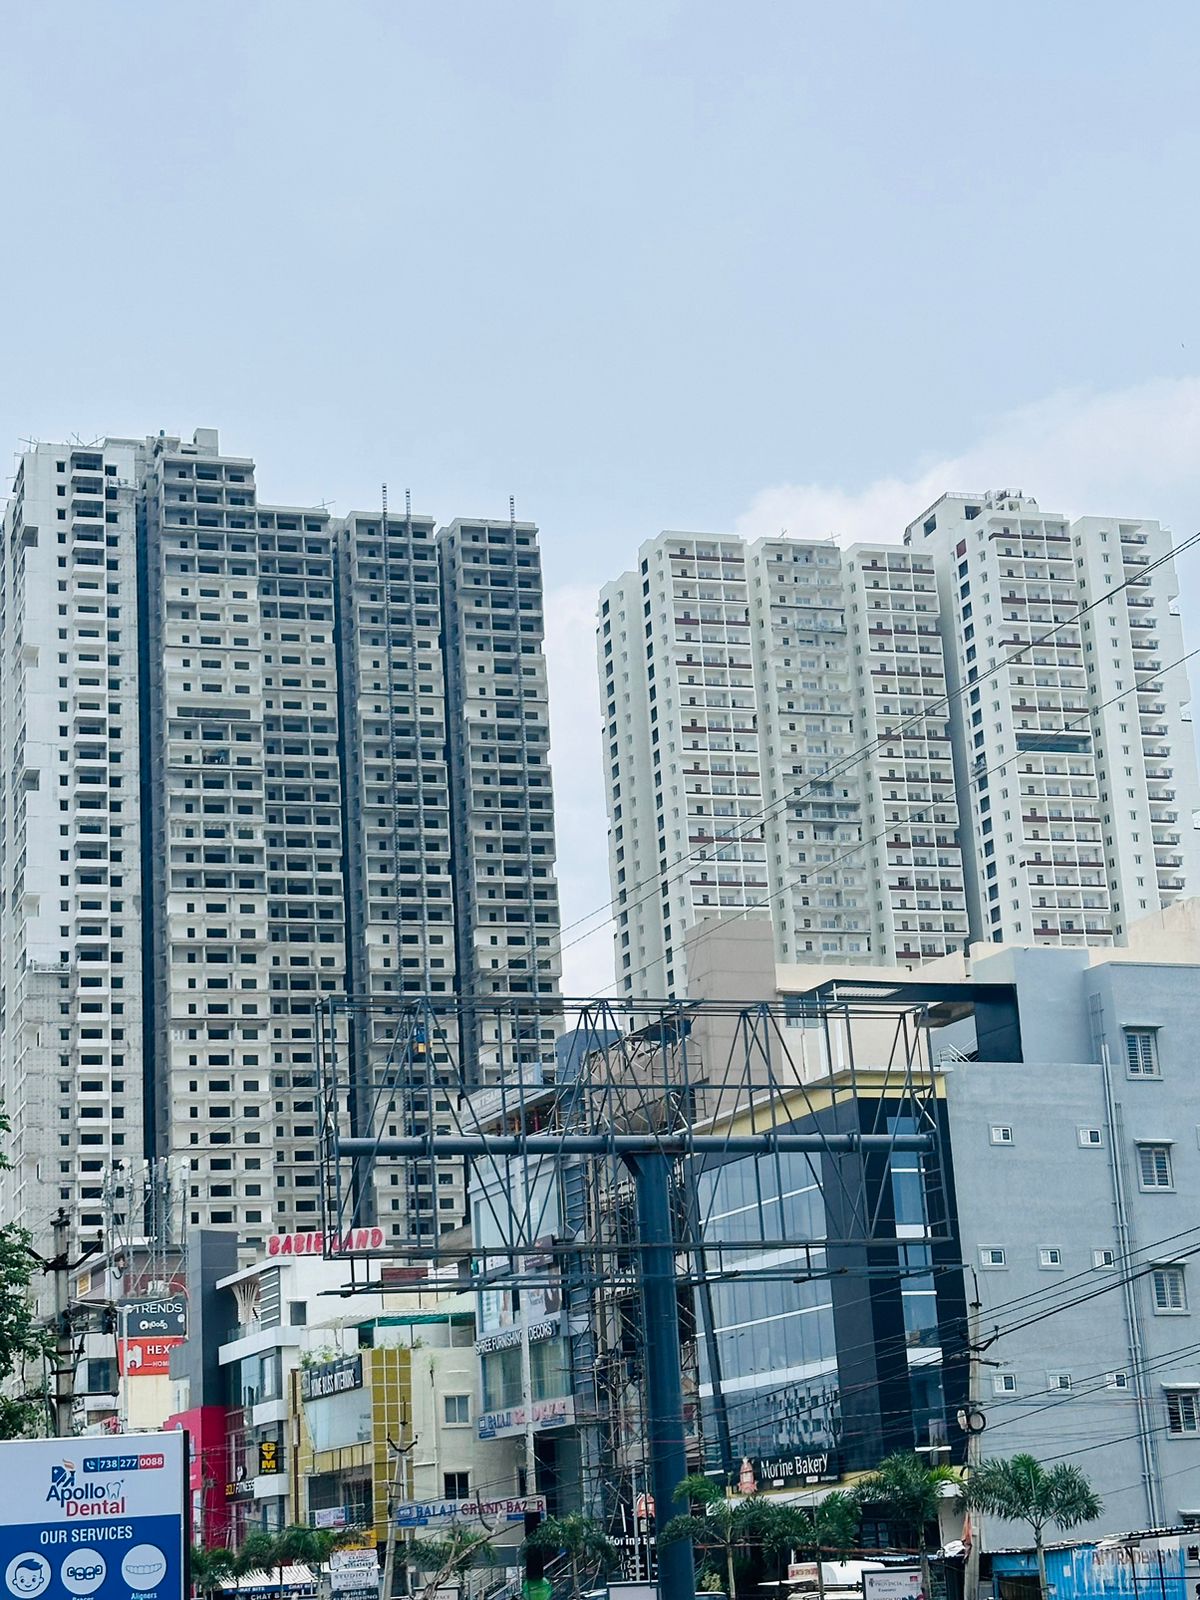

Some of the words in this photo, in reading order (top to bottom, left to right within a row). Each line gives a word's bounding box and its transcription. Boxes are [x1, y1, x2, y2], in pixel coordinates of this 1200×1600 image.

[269, 1234, 324, 1255] BABIE
[332, 1228, 383, 1251] LAND
[136, 1303, 183, 1314] TRENDS
[529, 1321, 552, 1341] DECORS
[100, 1460, 118, 1469] 738
[120, 1458, 137, 1468] 277
[140, 1457, 163, 1467] 0088
[262, 1442, 276, 1469] GYM
[760, 1458, 793, 1479] Morine
[794, 1453, 828, 1474] Bakery
[46, 1483, 106, 1508] Apollo
[66, 1496, 126, 1517] Dental
[416, 1504, 456, 1517] BALAJI
[506, 1500, 544, 1513] BAZR
[40, 1530, 67, 1545] OUR
[71, 1525, 133, 1542] SERVICES
[130, 1592, 157, 1600] Aligners
